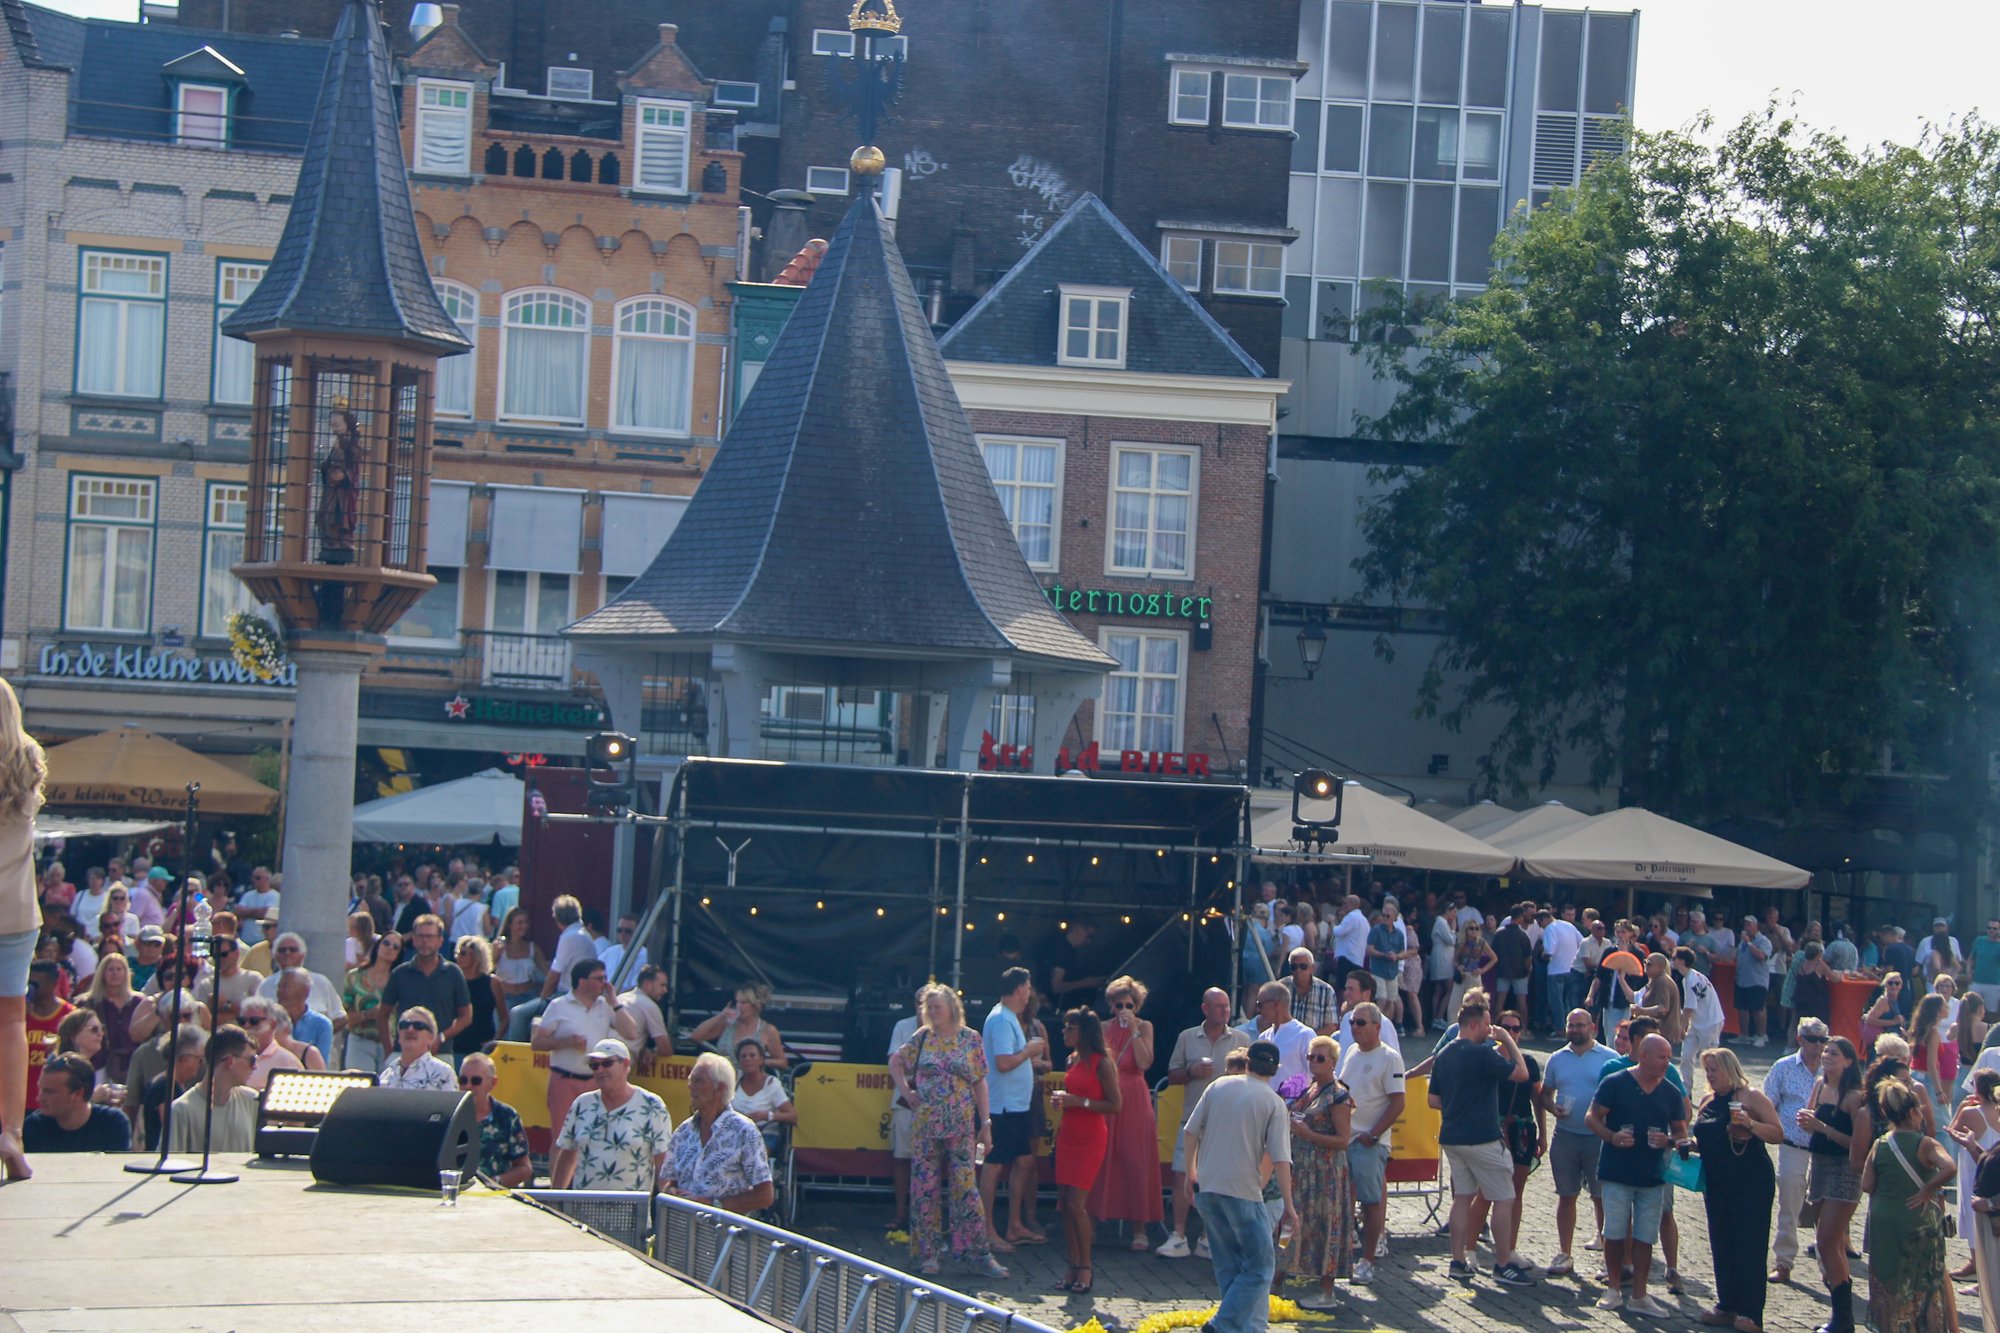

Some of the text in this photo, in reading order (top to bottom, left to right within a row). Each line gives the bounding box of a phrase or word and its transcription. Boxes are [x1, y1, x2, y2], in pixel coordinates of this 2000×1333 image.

[1043, 584, 1212, 619] ternoster
[40, 645, 70, 675] In
[76, 643, 107, 677] de
[114, 646, 201, 682] kleine
[475, 698, 600, 723] Heineken
[1121, 750, 1211, 777] BIER
[130, 786, 199, 807] Were
